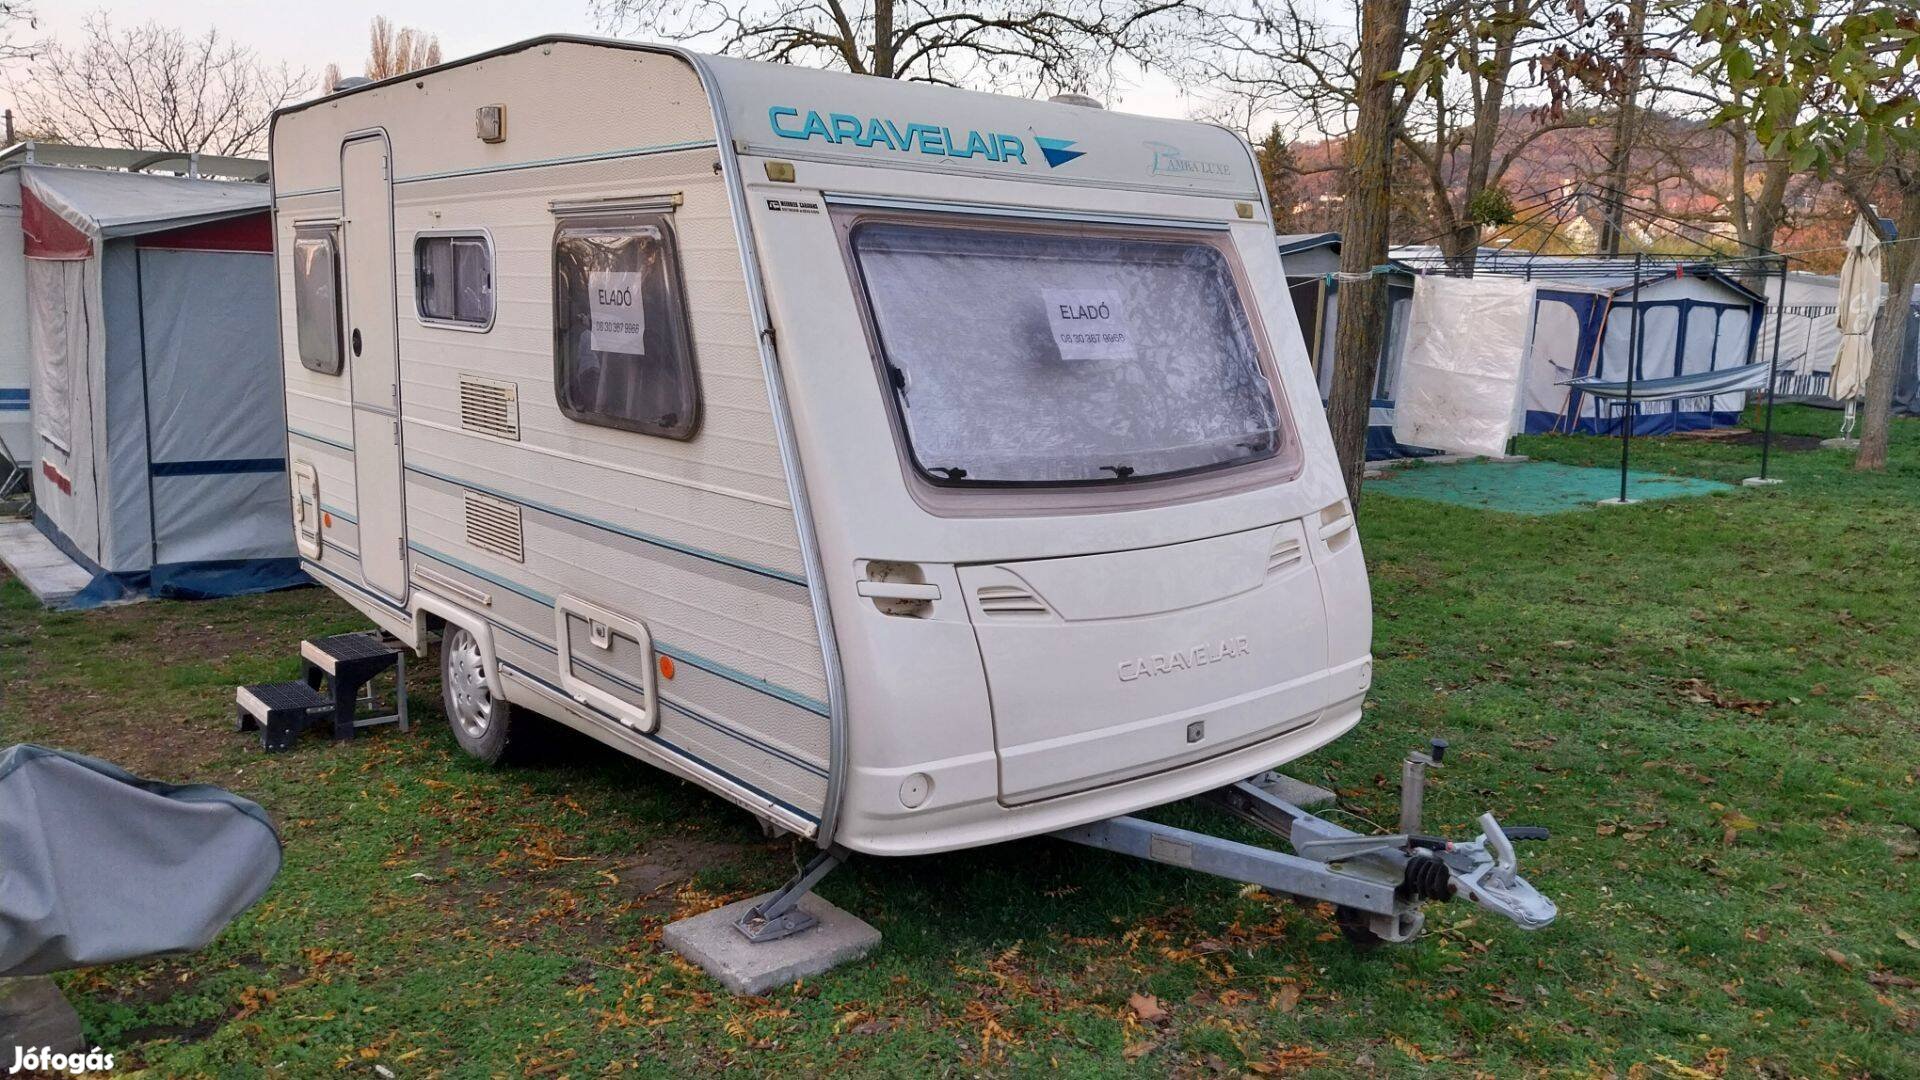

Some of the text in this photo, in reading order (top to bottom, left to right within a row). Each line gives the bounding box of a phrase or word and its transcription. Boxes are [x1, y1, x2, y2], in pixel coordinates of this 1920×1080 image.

[768, 105, 1027, 165] CARAVELAIR
[598, 287, 632, 307] ELADÓ
[1060, 302, 1110, 320] ELADÓ
[604, 321, 613, 332] 30
[1073, 334, 1085, 343] 30
[1118, 634, 1251, 682] CARAVELAIR
